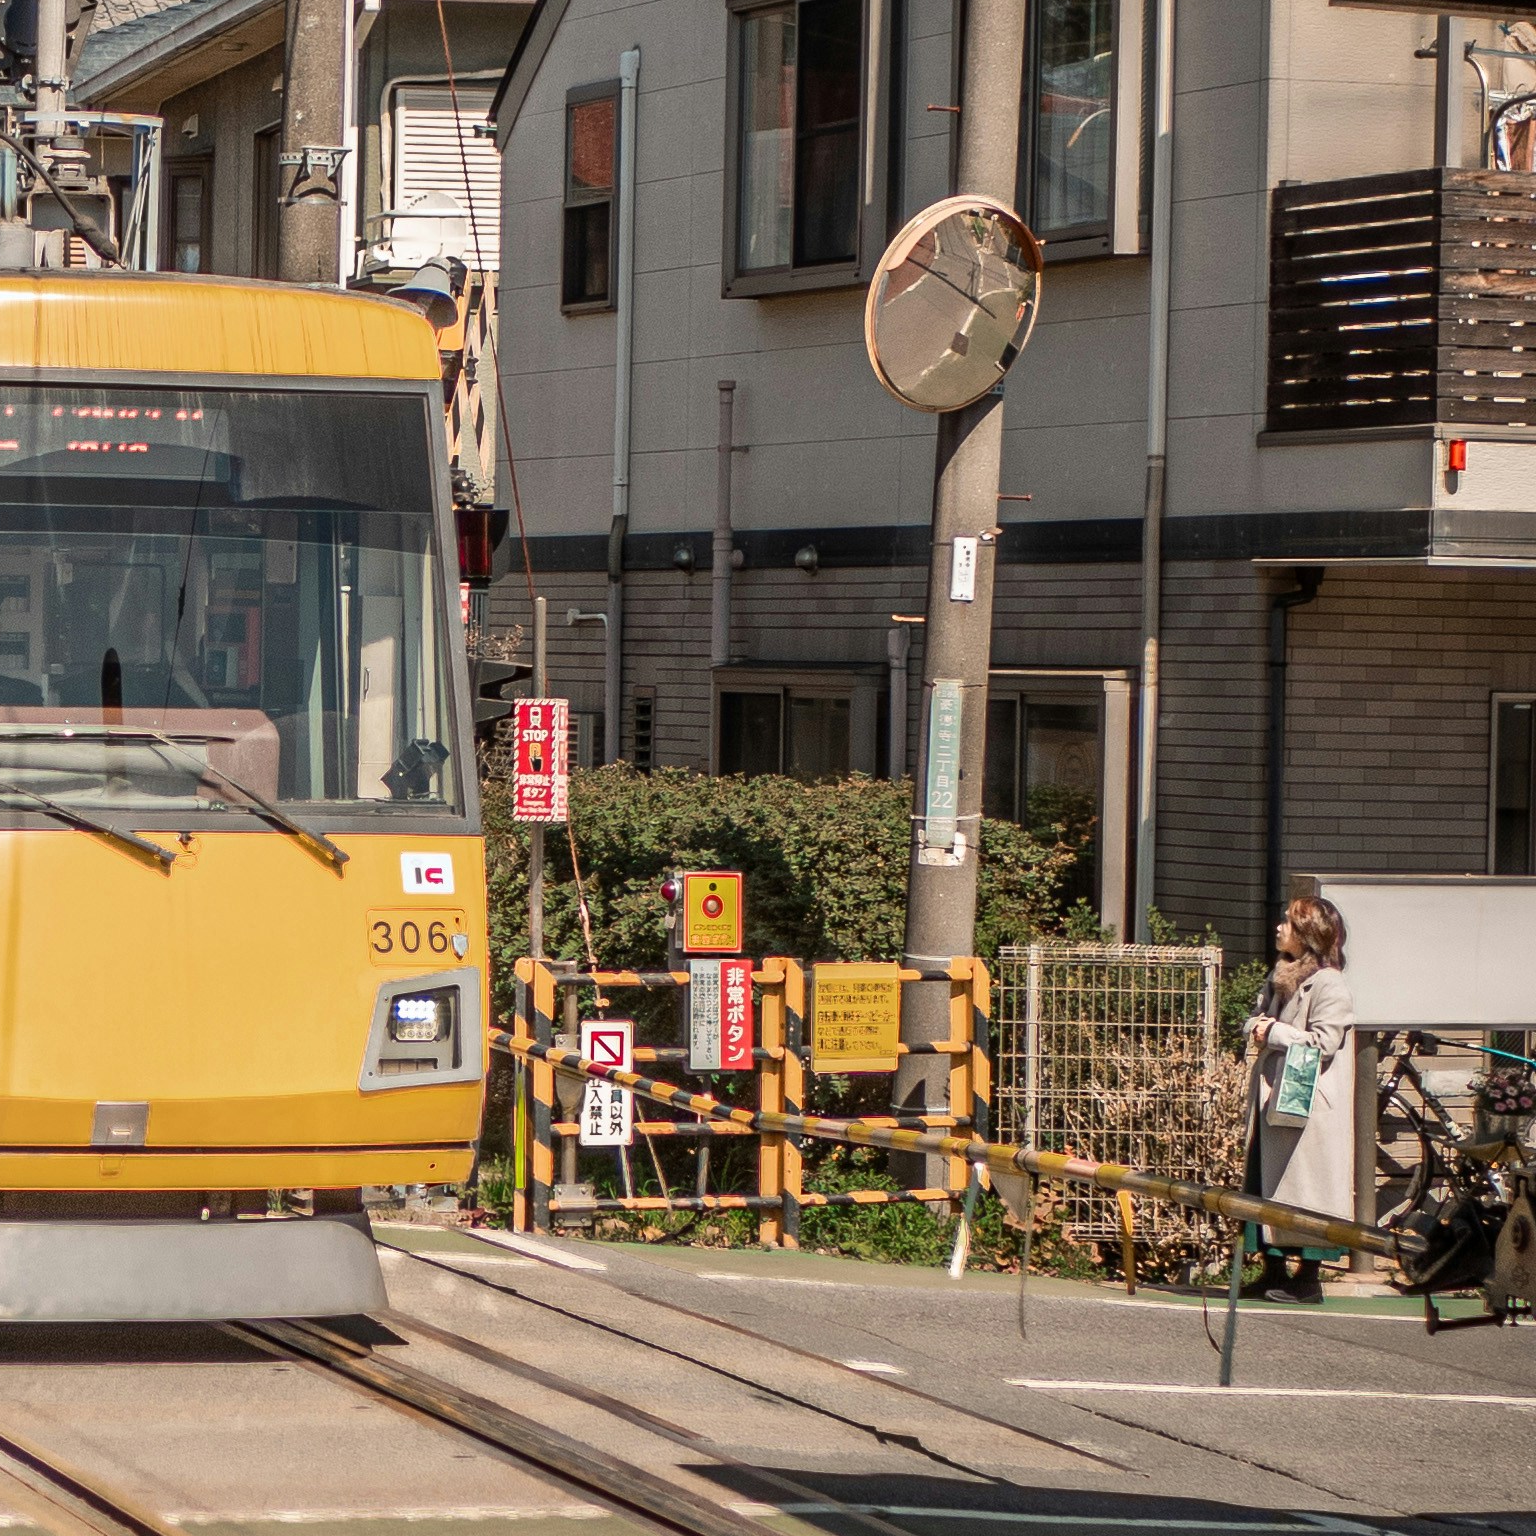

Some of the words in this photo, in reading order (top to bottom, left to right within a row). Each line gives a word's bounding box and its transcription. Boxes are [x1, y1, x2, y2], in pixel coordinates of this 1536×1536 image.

[522, 729, 549, 742] STOP
[522, 786, 547, 798] ボタン
[931, 791, 953, 809] 22
[371, 920, 449, 954] 306
[726, 967, 745, 1062] 非常ボタン
[610, 1084, 624, 1136] 員以外
